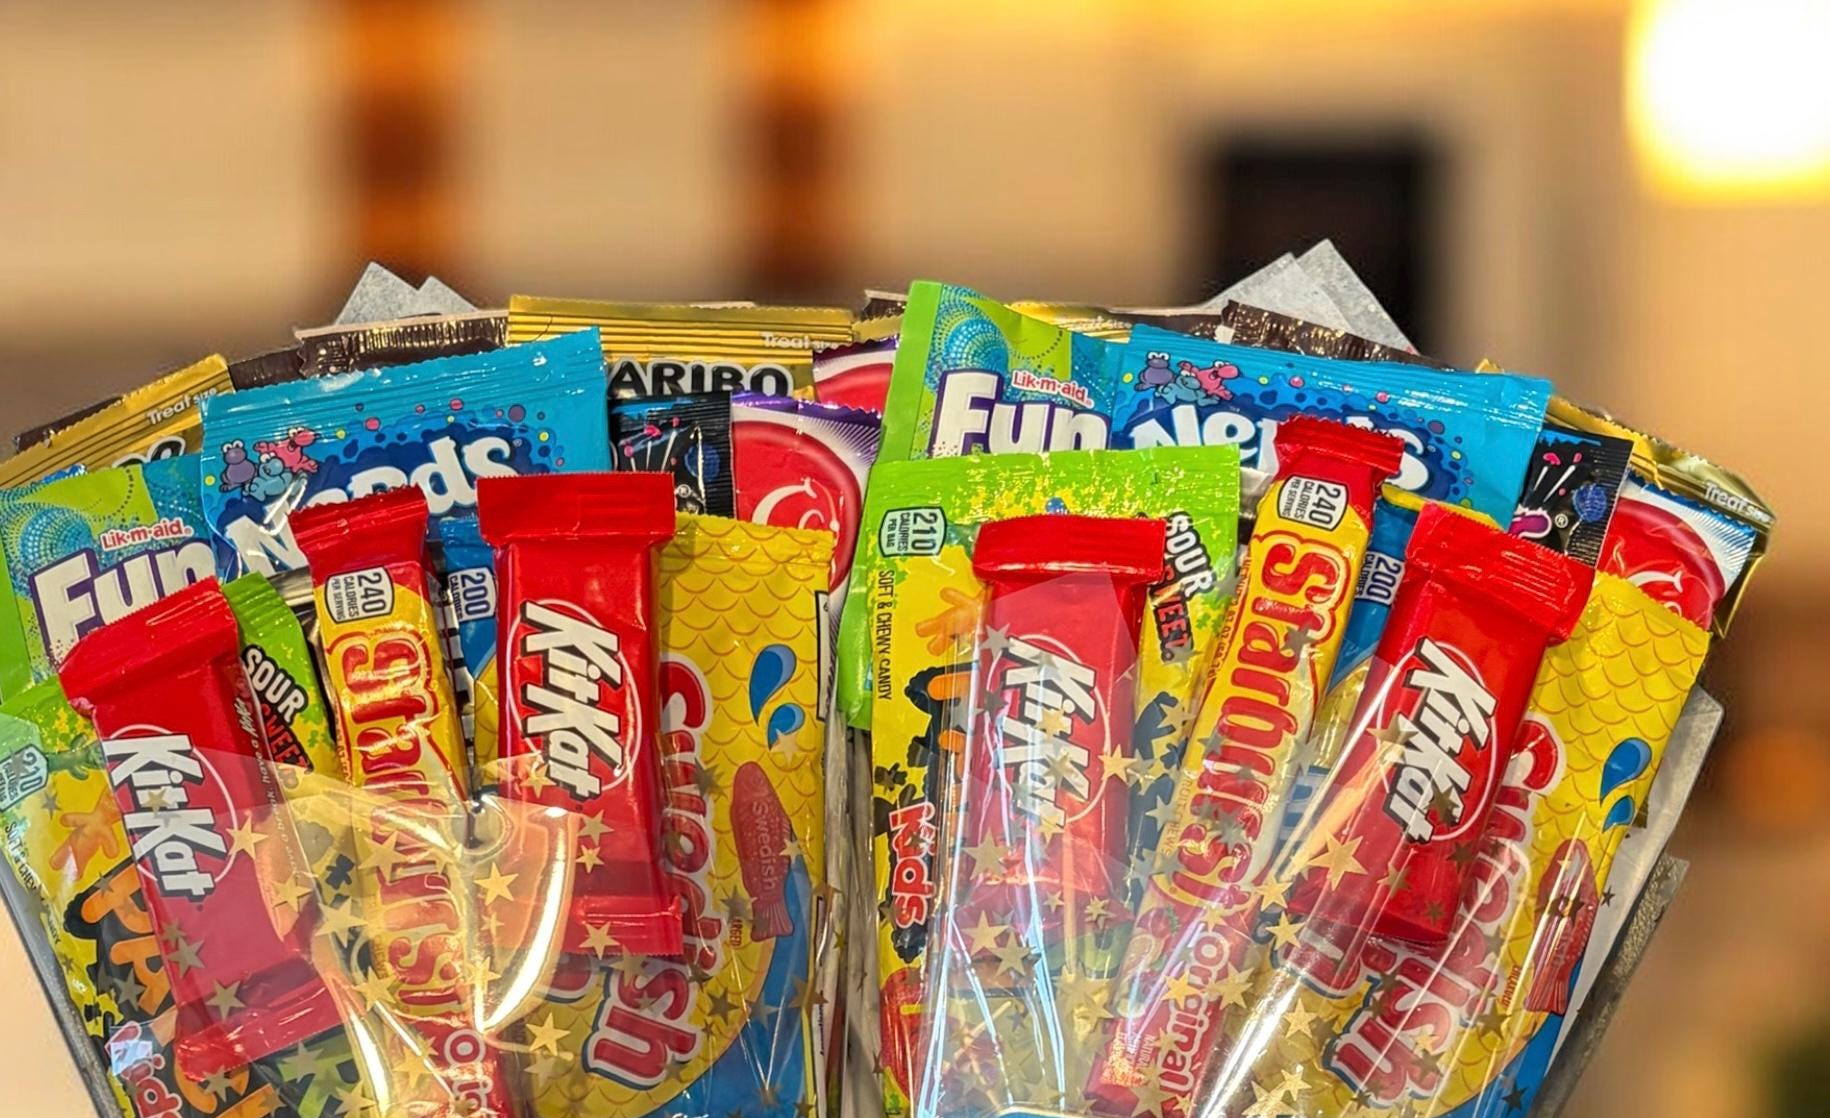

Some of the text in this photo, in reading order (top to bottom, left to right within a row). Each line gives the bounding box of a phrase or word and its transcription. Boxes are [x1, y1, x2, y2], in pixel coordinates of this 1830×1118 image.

[761, 331, 811, 350] Treat
[607, 361, 792, 398] ARIBO
[147, 395, 191, 426] Treat
[932, 370, 1109, 458] Fun
[1133, 404, 1428, 492] Ners
[225, 436, 518, 577] Nds
[1280, 478, 1301, 517] PER SERVING
[1293, 480, 1316, 520] CALORIES
[1308, 484, 1342, 526] 240
[1704, 481, 1749, 513] Treat
[886, 518, 897, 548] PER BAG
[899, 512, 910, 552] CALORIES
[912, 512, 938, 553] 210
[1166, 513, 1214, 598] SOUR
[1354, 554, 1374, 597] CALORIES
[331, 577, 347, 621] PER SERVING
[342, 575, 360, 618] CALORIES
[357, 570, 387, 616] 240
[461, 571, 491, 617] 200
[877, 570, 896, 599] SOFT
[1366, 557, 1401, 600] 200
[876, 612, 893, 657] CHEWY
[245, 648, 305, 723] SOUR
[521, 602, 623, 798] KitKat
[876, 658, 893, 701] CANDY
[1173, 543, 1339, 903] Starburst
[1395, 637, 1498, 842] KitKat
[102, 734, 228, 898] KitKat
[752, 802, 778, 892] Swedish
[889, 801, 933, 928] Kids
[1158, 930, 1230, 1093] Orginal
